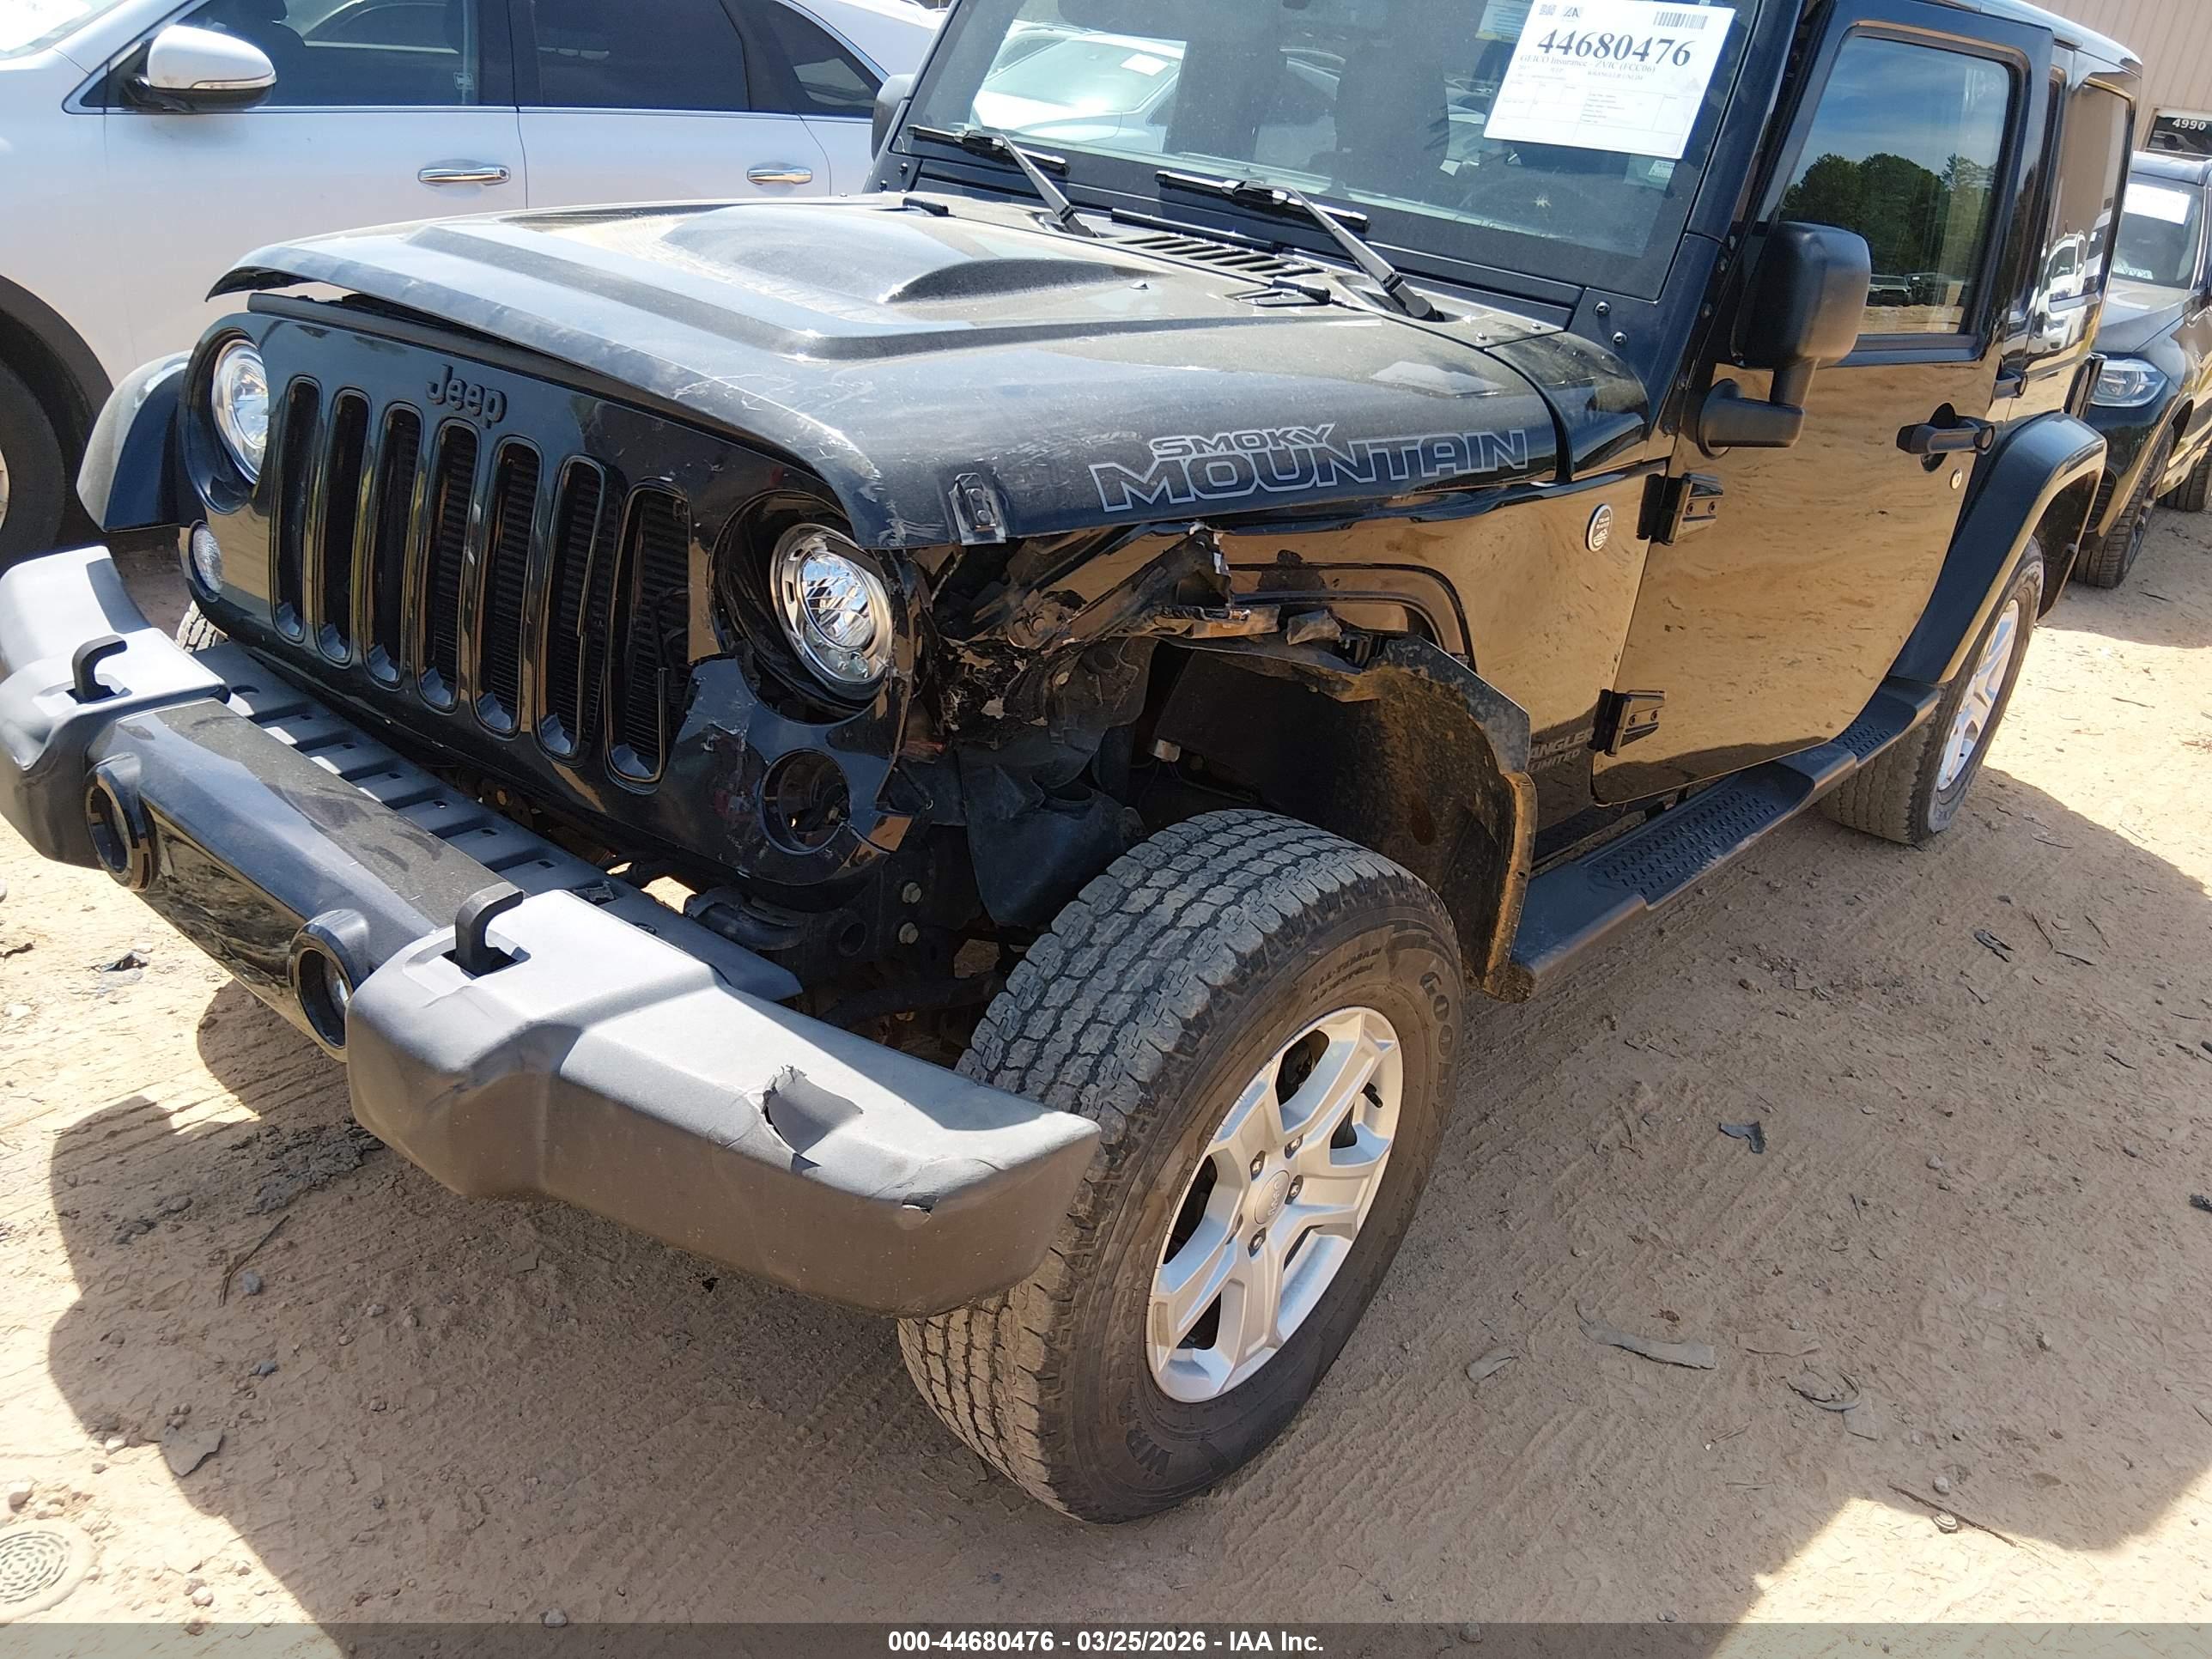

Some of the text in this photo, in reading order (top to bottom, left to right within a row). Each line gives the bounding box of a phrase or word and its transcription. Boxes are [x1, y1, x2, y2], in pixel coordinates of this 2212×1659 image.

[1520, 55, 1549, 64] GEICO
[1550, 57, 1587, 67] Insurance
[1537, 28, 1697, 67] 44680476
[2172, 118, 2207, 131] 4990
[426, 363, 507, 429] Jeep
[1148, 423, 1336, 461] SMOKY
[1088, 428, 1529, 513] MOUNTAIN
[1530, 727, 1595, 758] ANGLER
